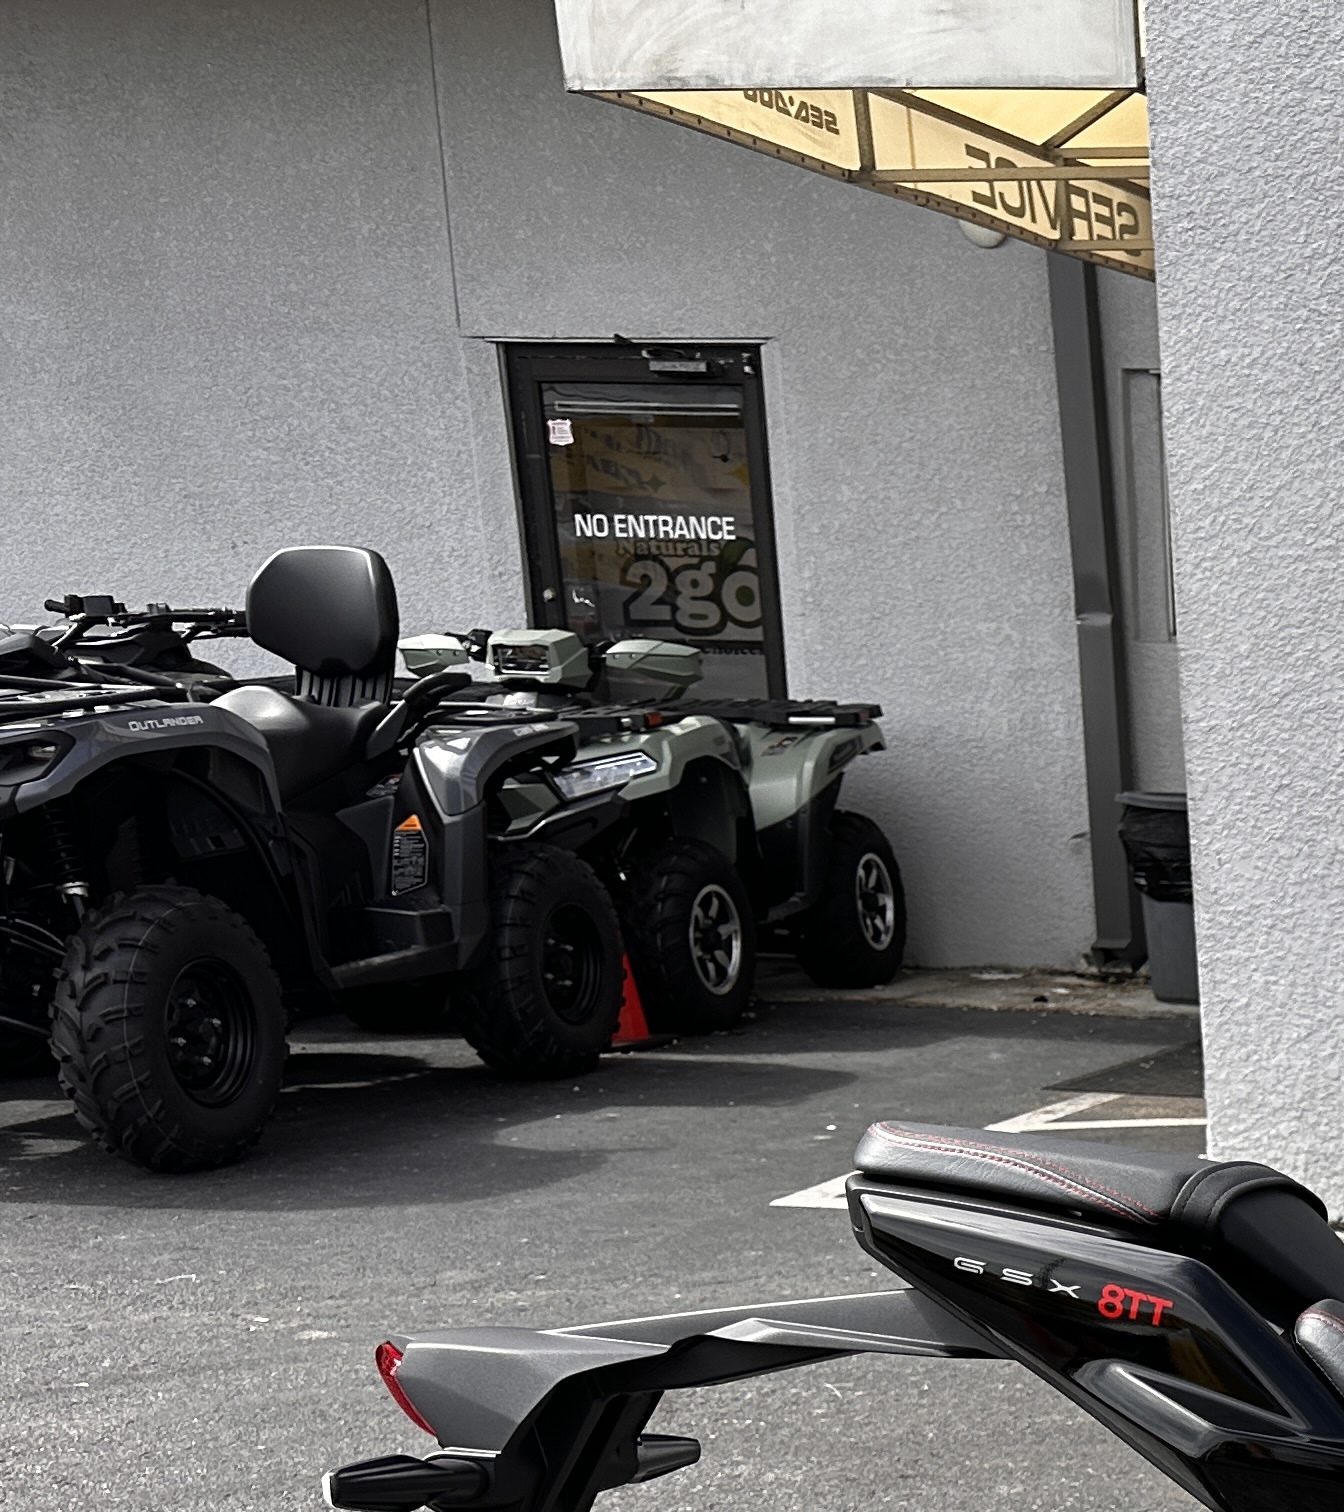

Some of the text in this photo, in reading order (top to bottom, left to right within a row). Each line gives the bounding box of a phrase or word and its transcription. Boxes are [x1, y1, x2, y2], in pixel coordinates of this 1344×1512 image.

[574, 513, 736, 541] NO ENTRANCE
[128, 715, 204, 732] OUTLANDER
[953, 1256, 1173, 1327] GSX 8TT
